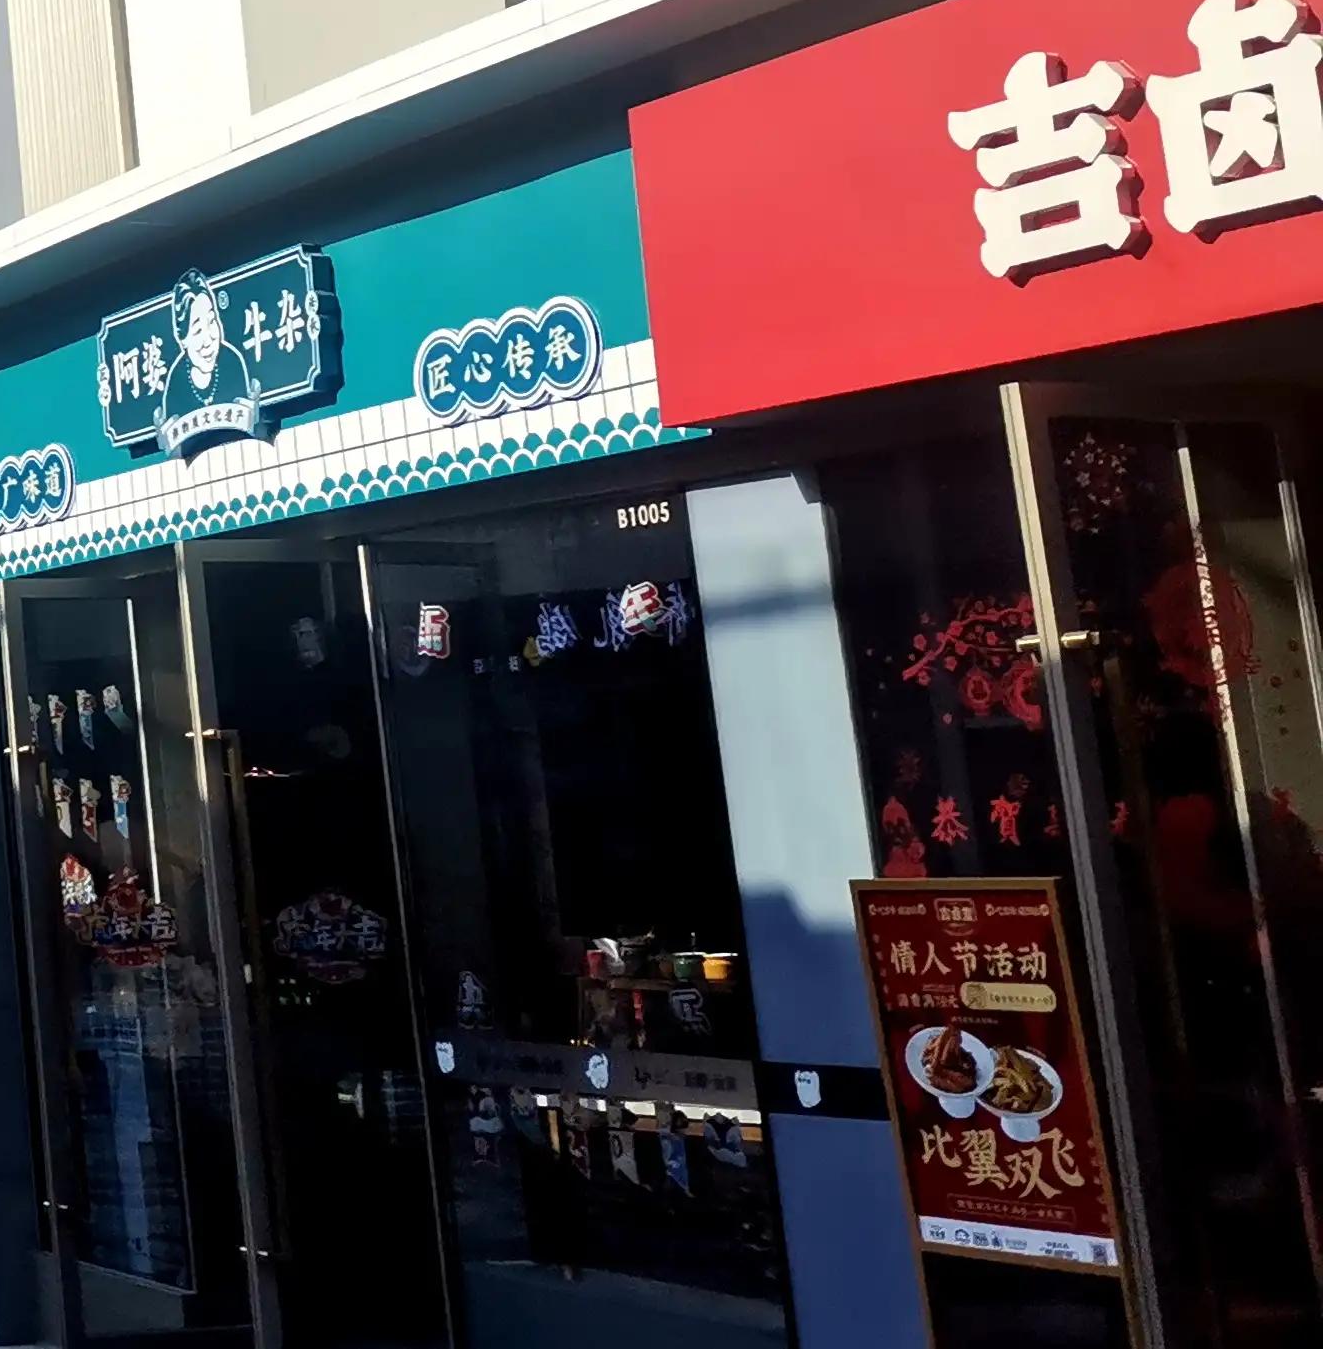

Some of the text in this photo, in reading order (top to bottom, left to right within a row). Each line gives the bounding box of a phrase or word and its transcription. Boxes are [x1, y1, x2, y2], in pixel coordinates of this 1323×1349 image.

[113, 289, 304, 403] 阿婆 牛杂
[427, 324, 582, 400] 匠心传承
[617, 502, 670, 529] B1005
[890, 939, 1047, 980] 情人节活动
[919, 1124, 1085, 1199] 比翼双飞
